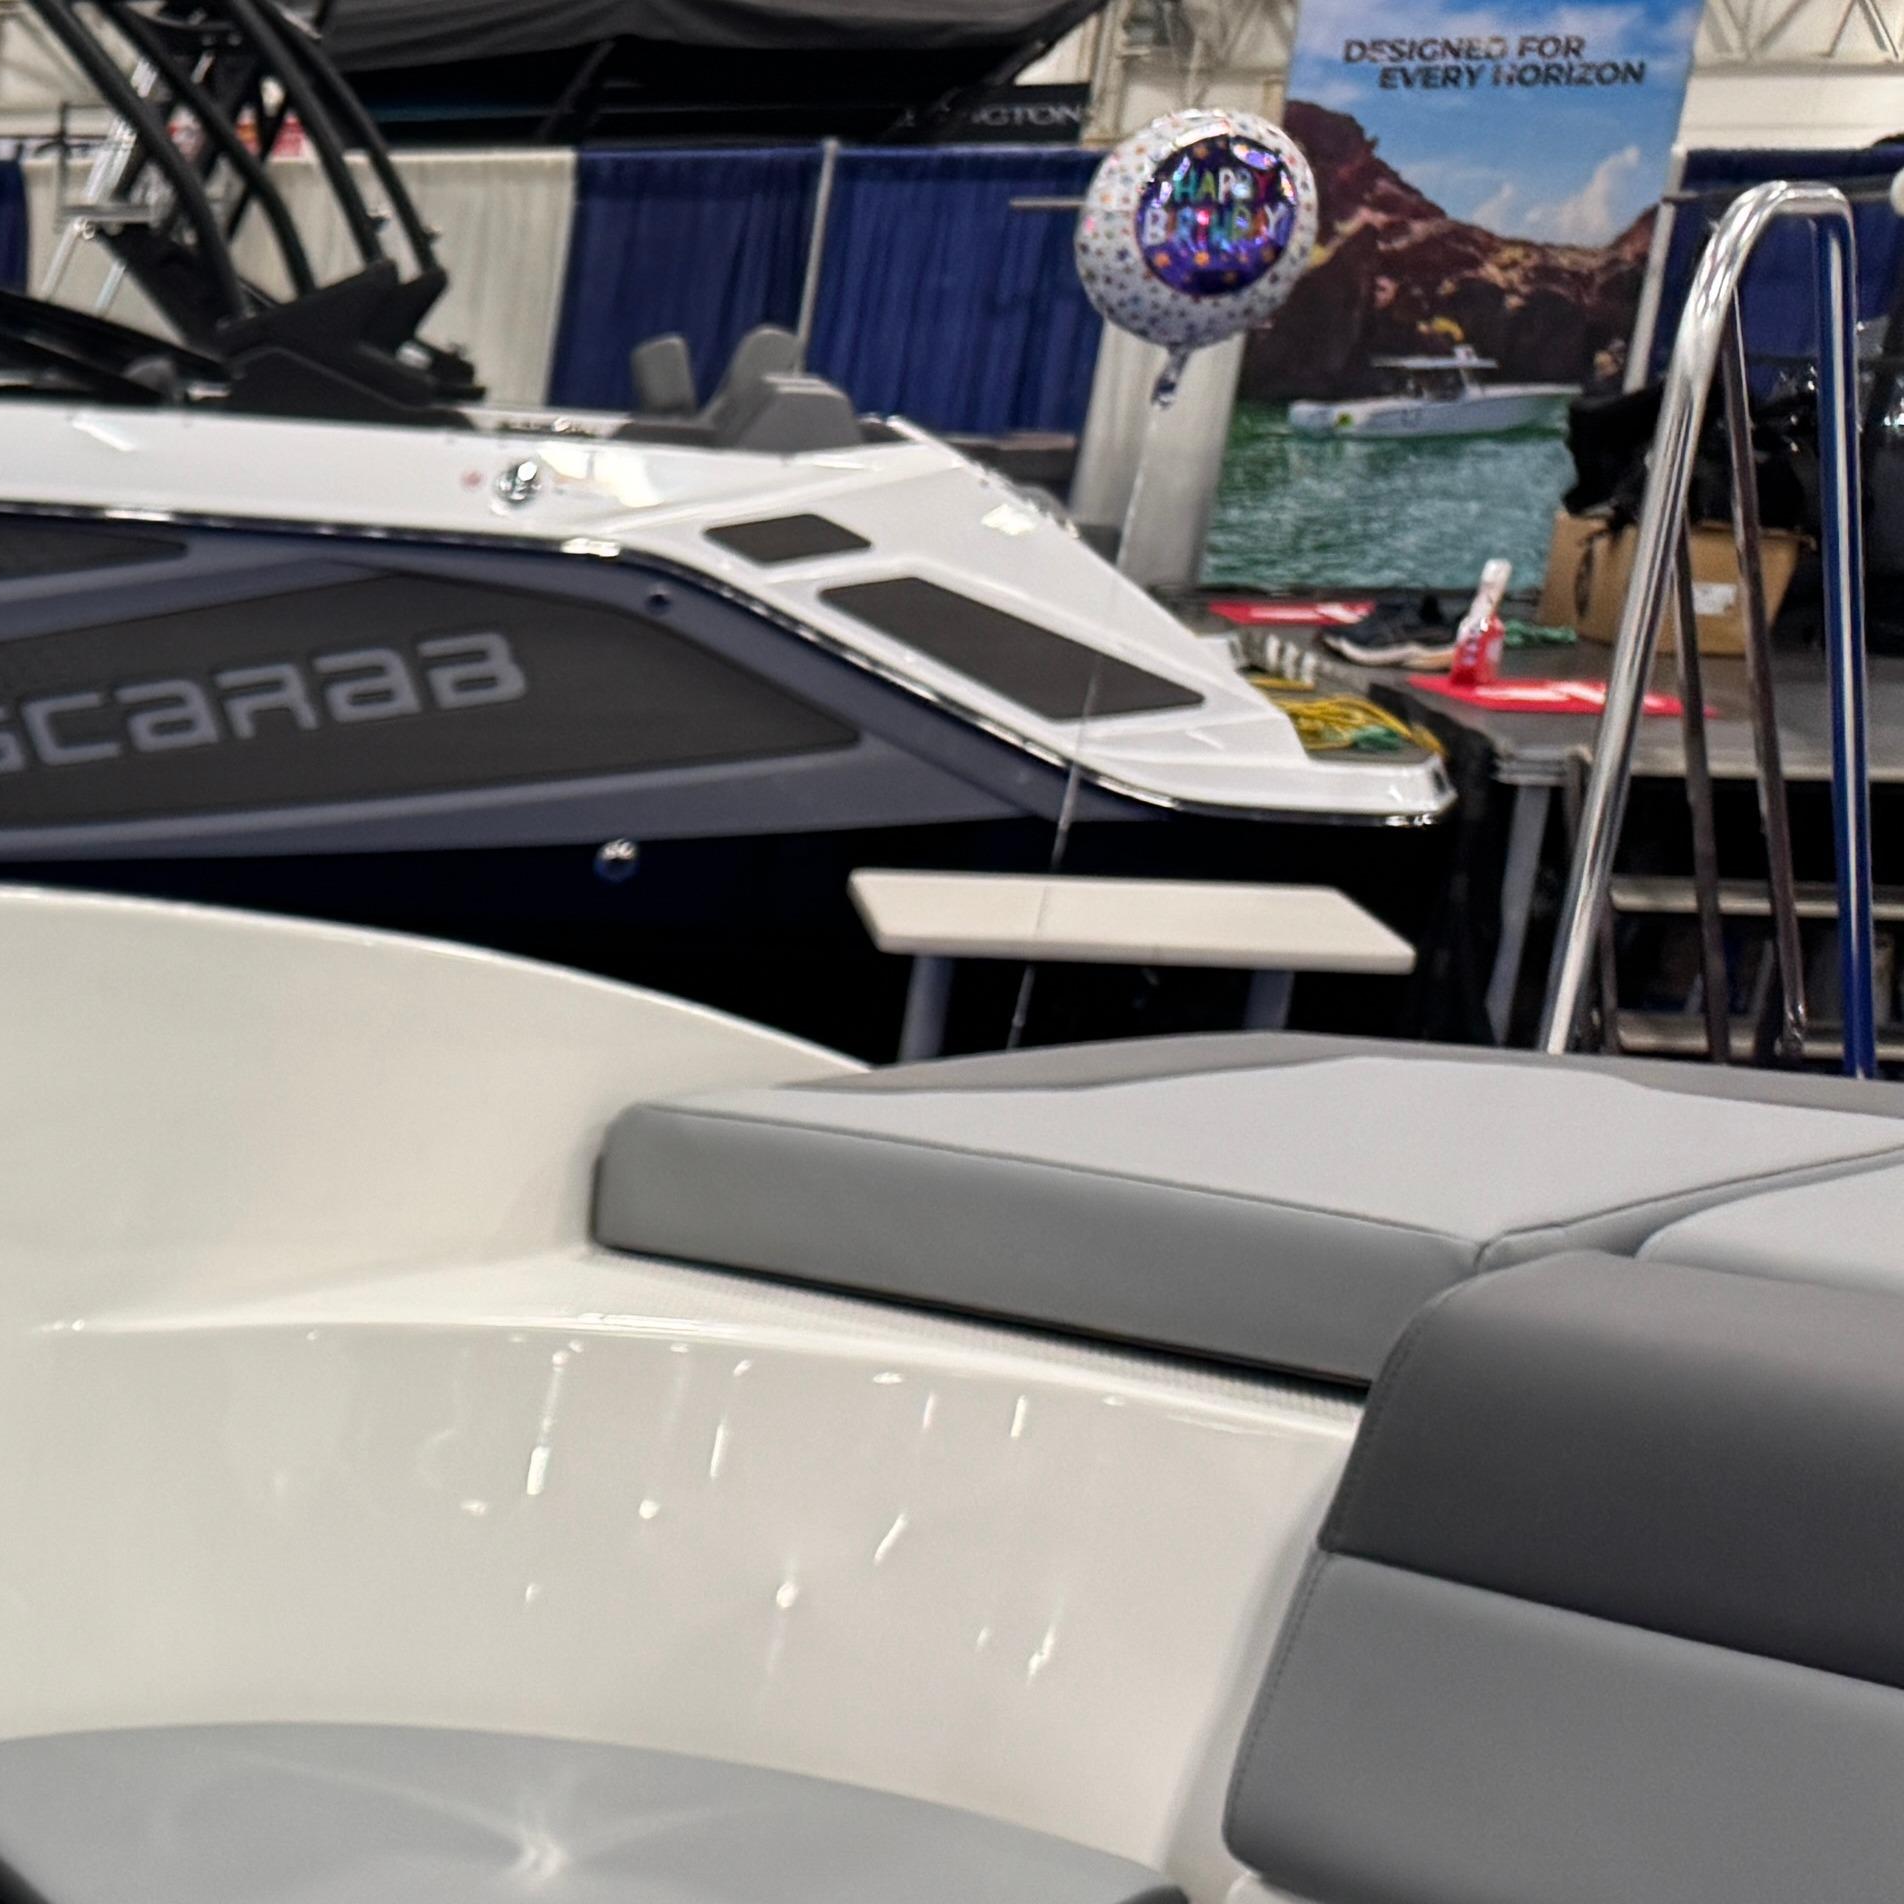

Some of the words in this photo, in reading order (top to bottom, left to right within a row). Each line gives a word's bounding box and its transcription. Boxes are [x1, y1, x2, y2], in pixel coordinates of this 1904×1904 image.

[1344, 37, 1508, 63] DESIGNED
[1517, 35, 1585, 58] FOR
[1378, 63, 1485, 89] EVERY
[1493, 61, 1646, 87] HORIZON
[1173, 167, 1272, 202] HAPPY
[1143, 202, 1288, 246] BIRTHDAY
